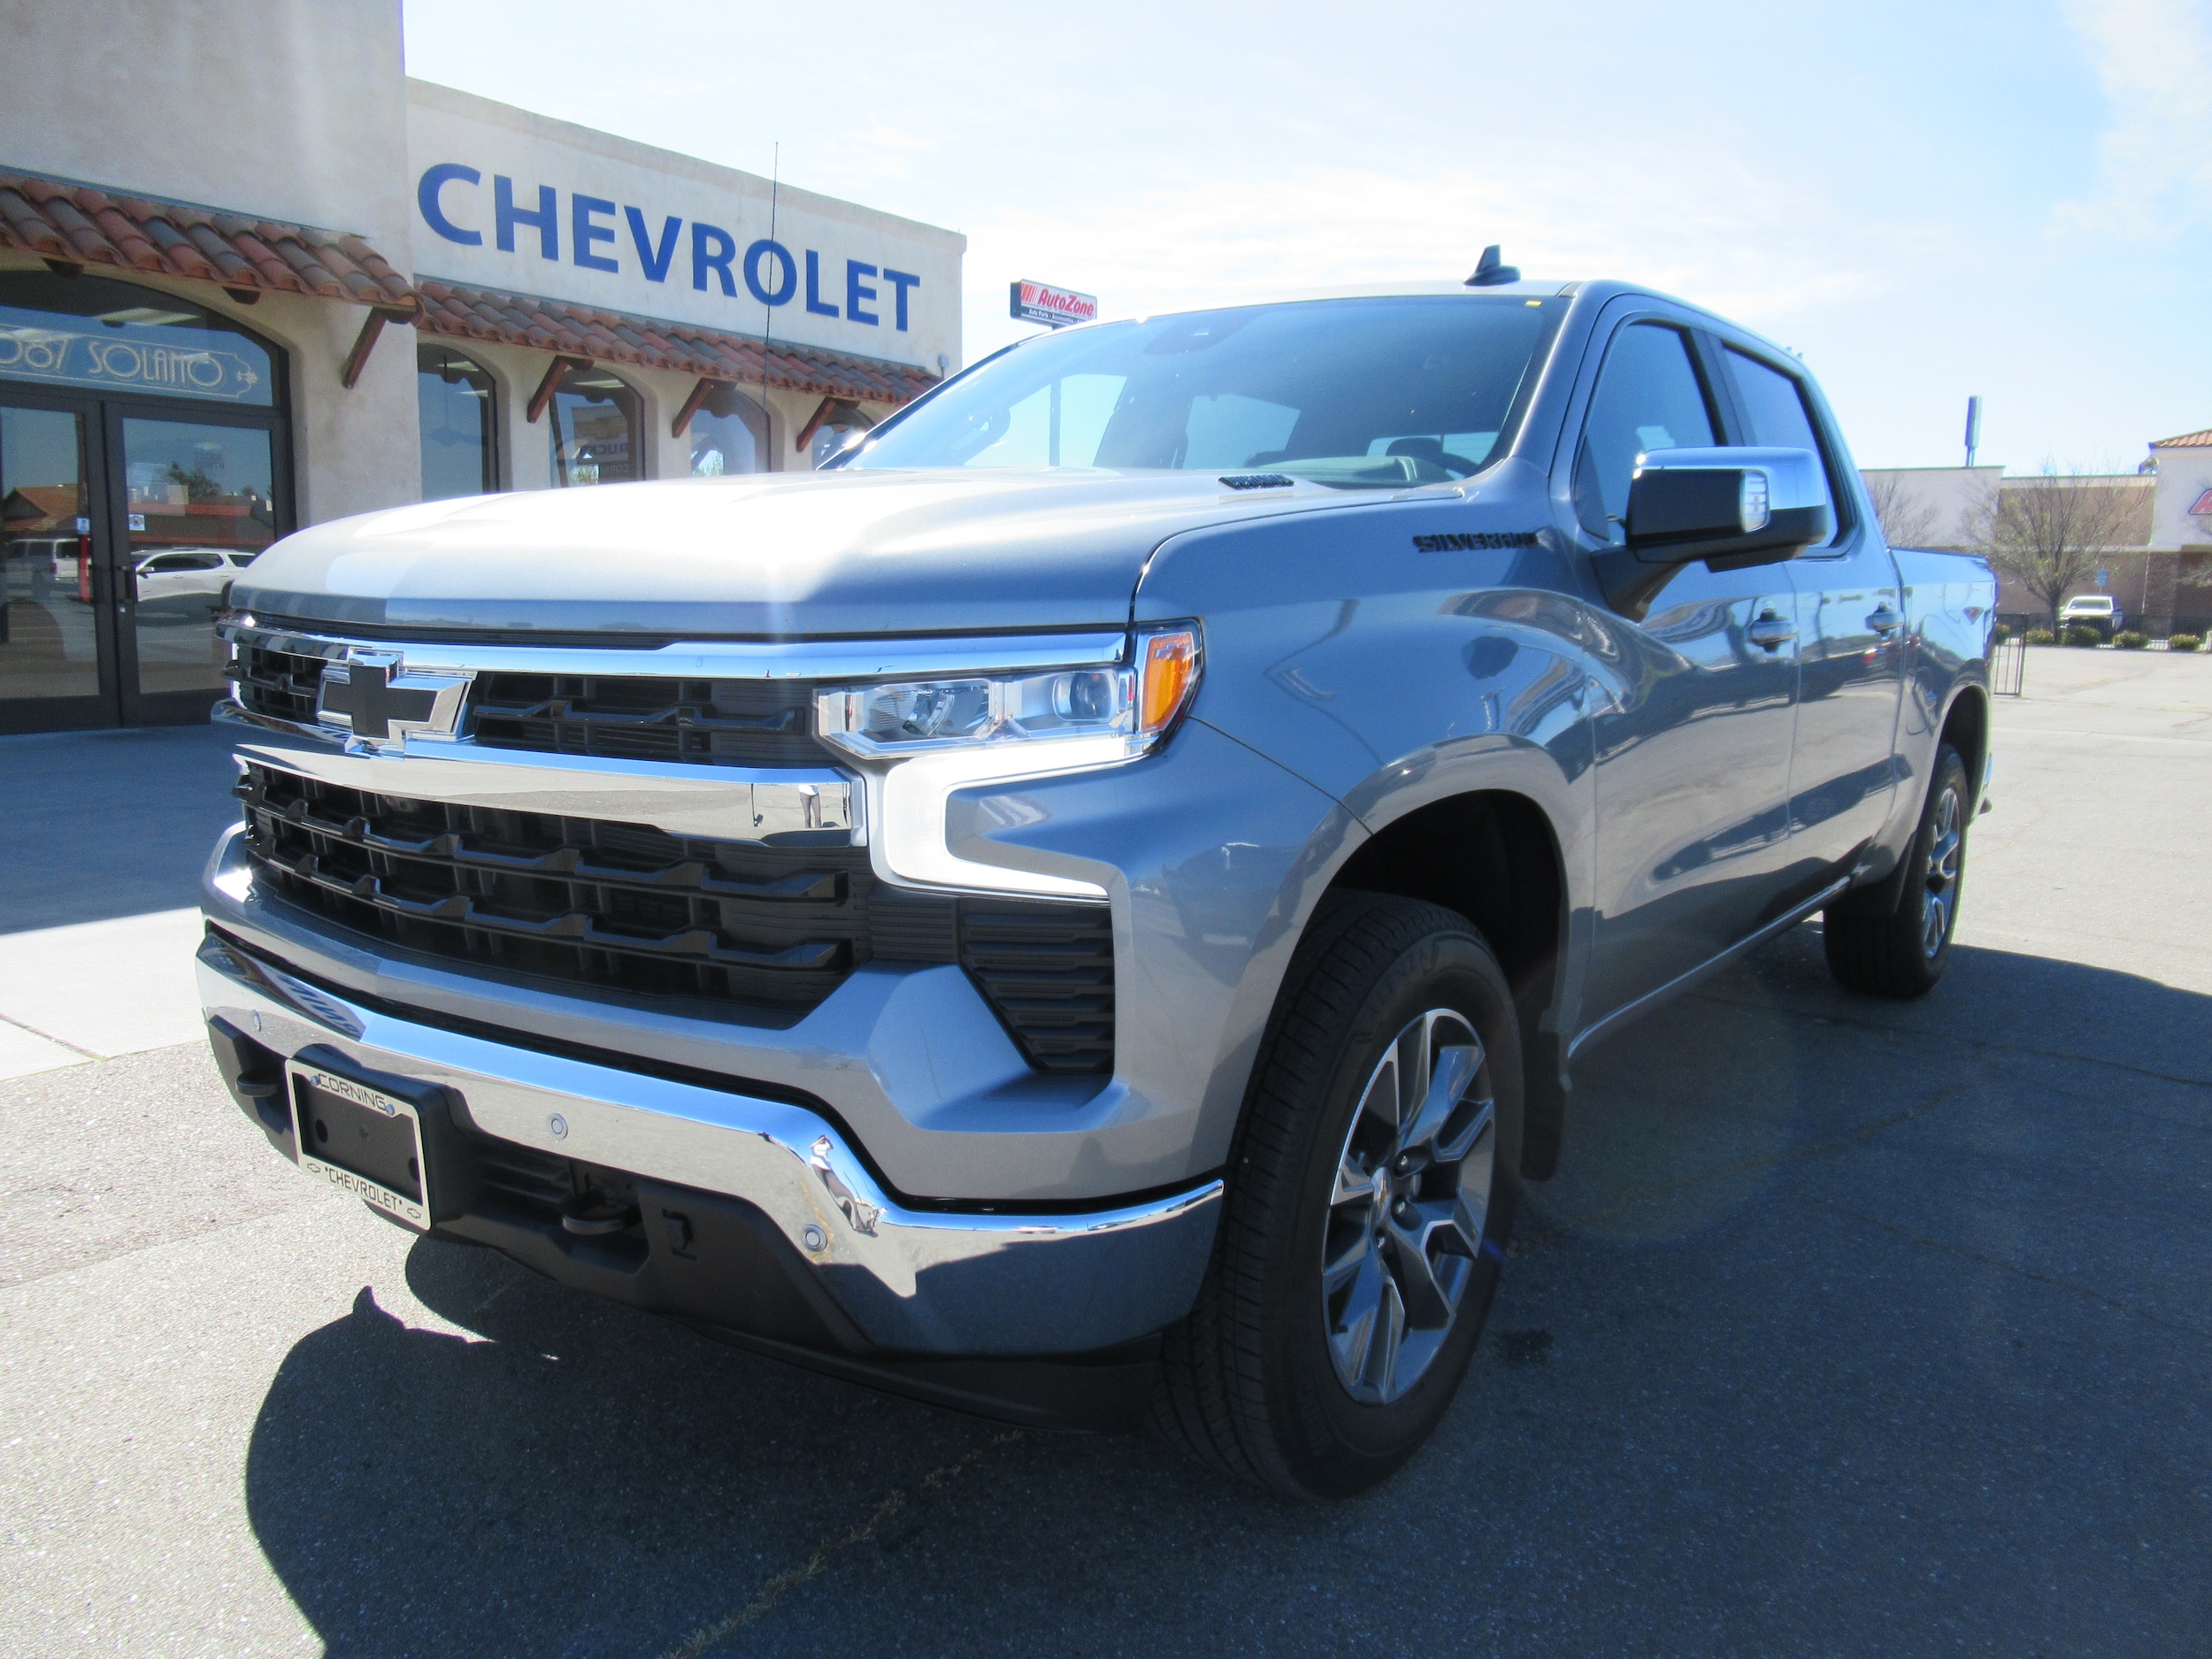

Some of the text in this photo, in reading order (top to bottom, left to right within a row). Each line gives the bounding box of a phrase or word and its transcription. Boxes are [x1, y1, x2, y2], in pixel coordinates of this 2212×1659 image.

[417, 162, 922, 333] CHEVROLET
[1038, 288, 1094, 317] AutoZone
[88, 342, 223, 387] SOLANO
[318, 1072, 388, 1111] CORNING
[328, 1166, 400, 1211] CHEVROLET
